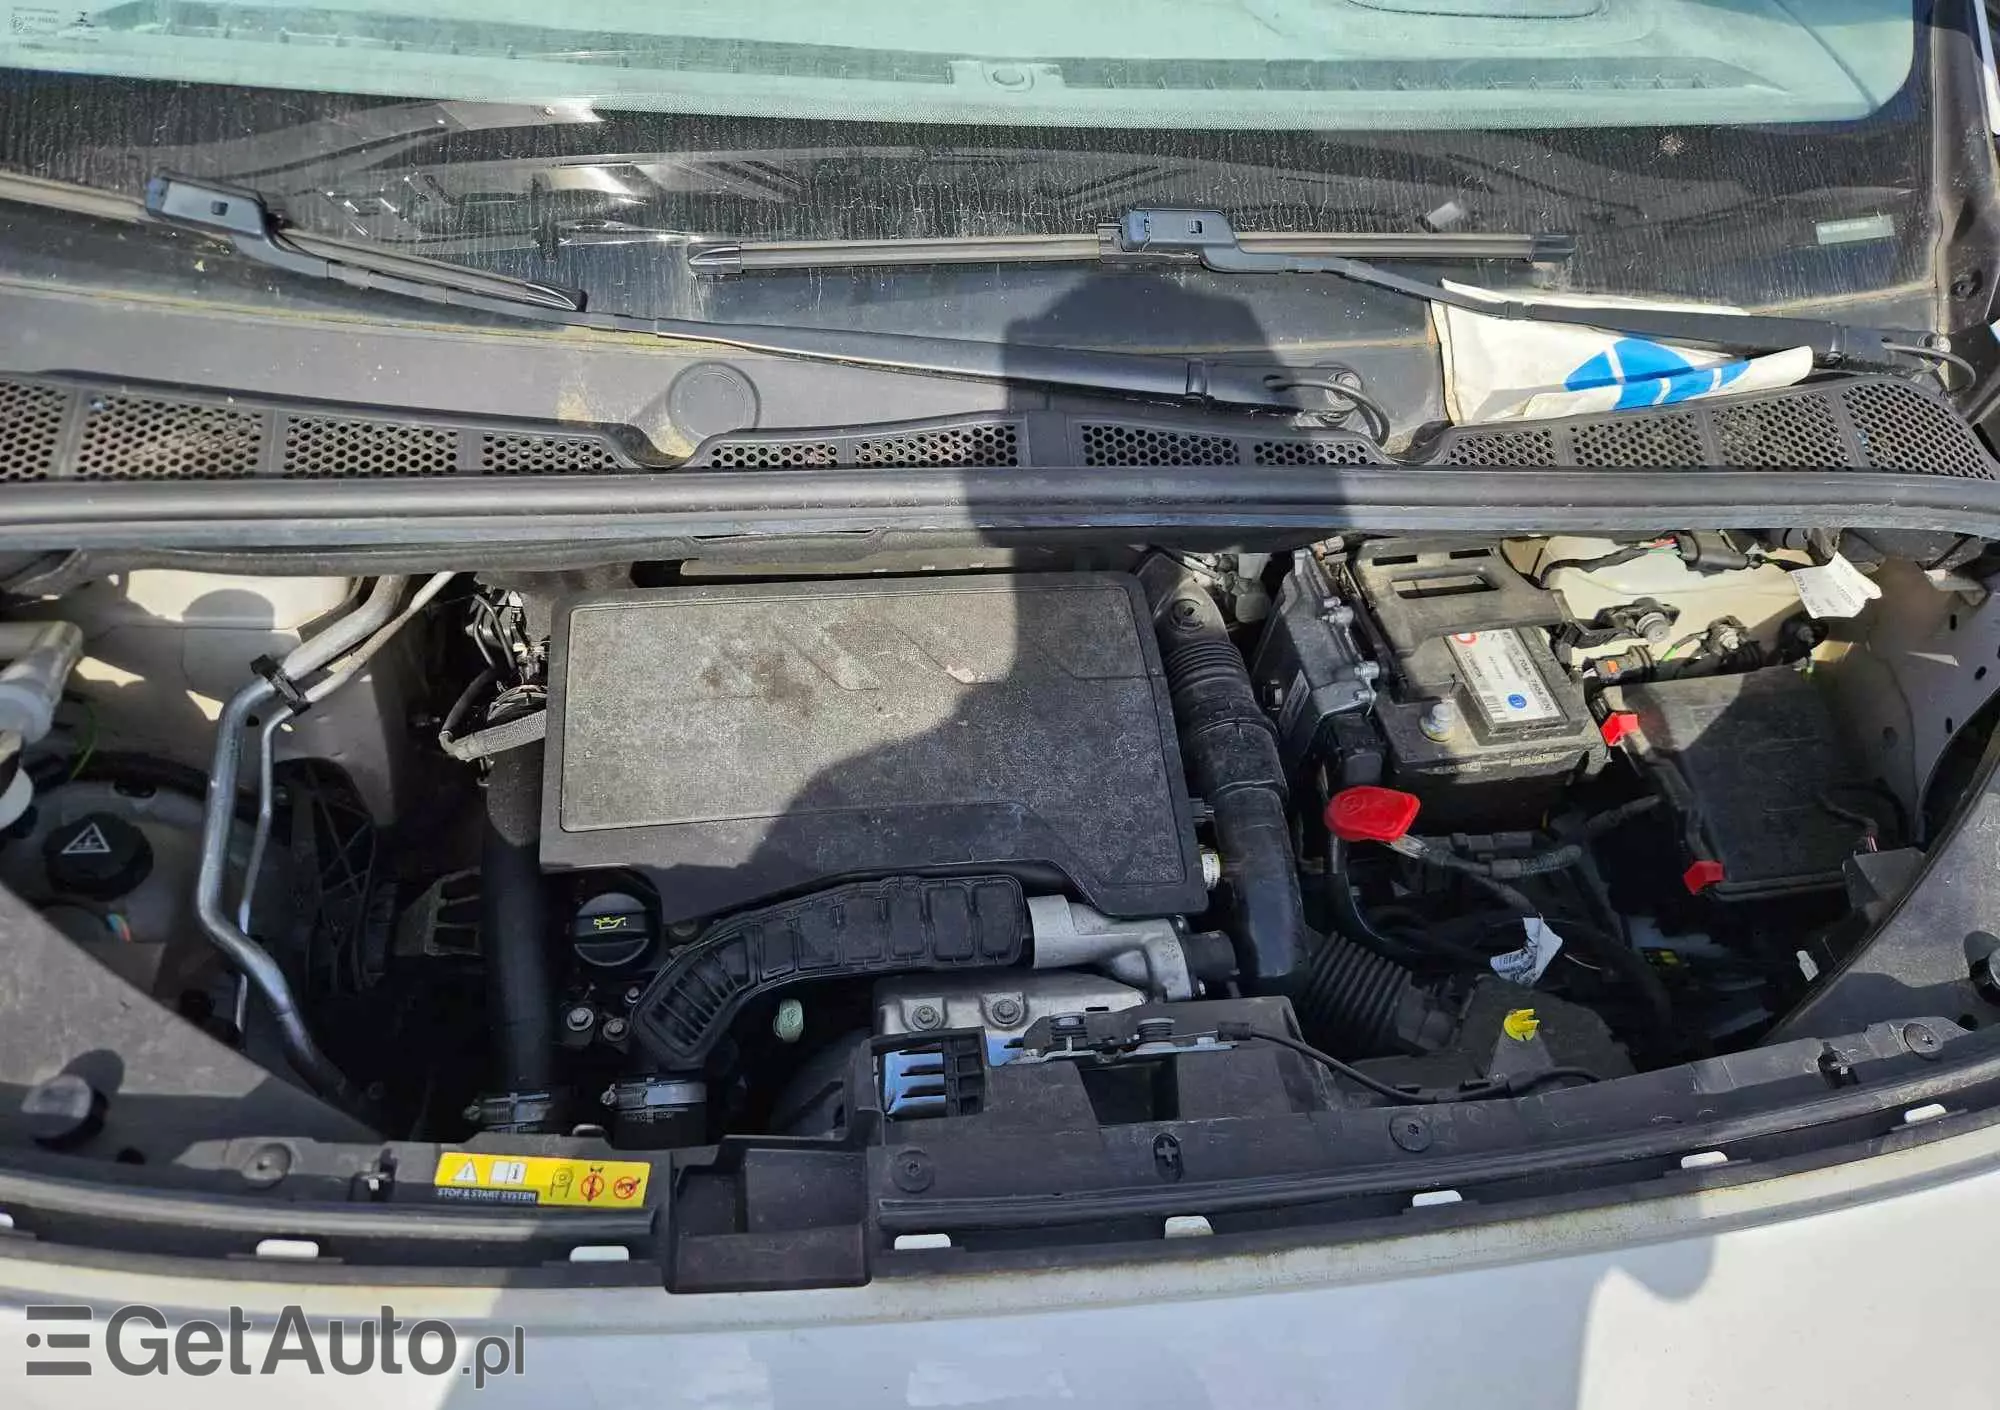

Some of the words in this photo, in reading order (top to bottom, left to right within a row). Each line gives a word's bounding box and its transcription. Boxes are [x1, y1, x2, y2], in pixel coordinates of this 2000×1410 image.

[438, 1188, 462, 1197] STOP
[471, 1190, 501, 1199] START
[502, 1191, 537, 1201] SYSTEM
